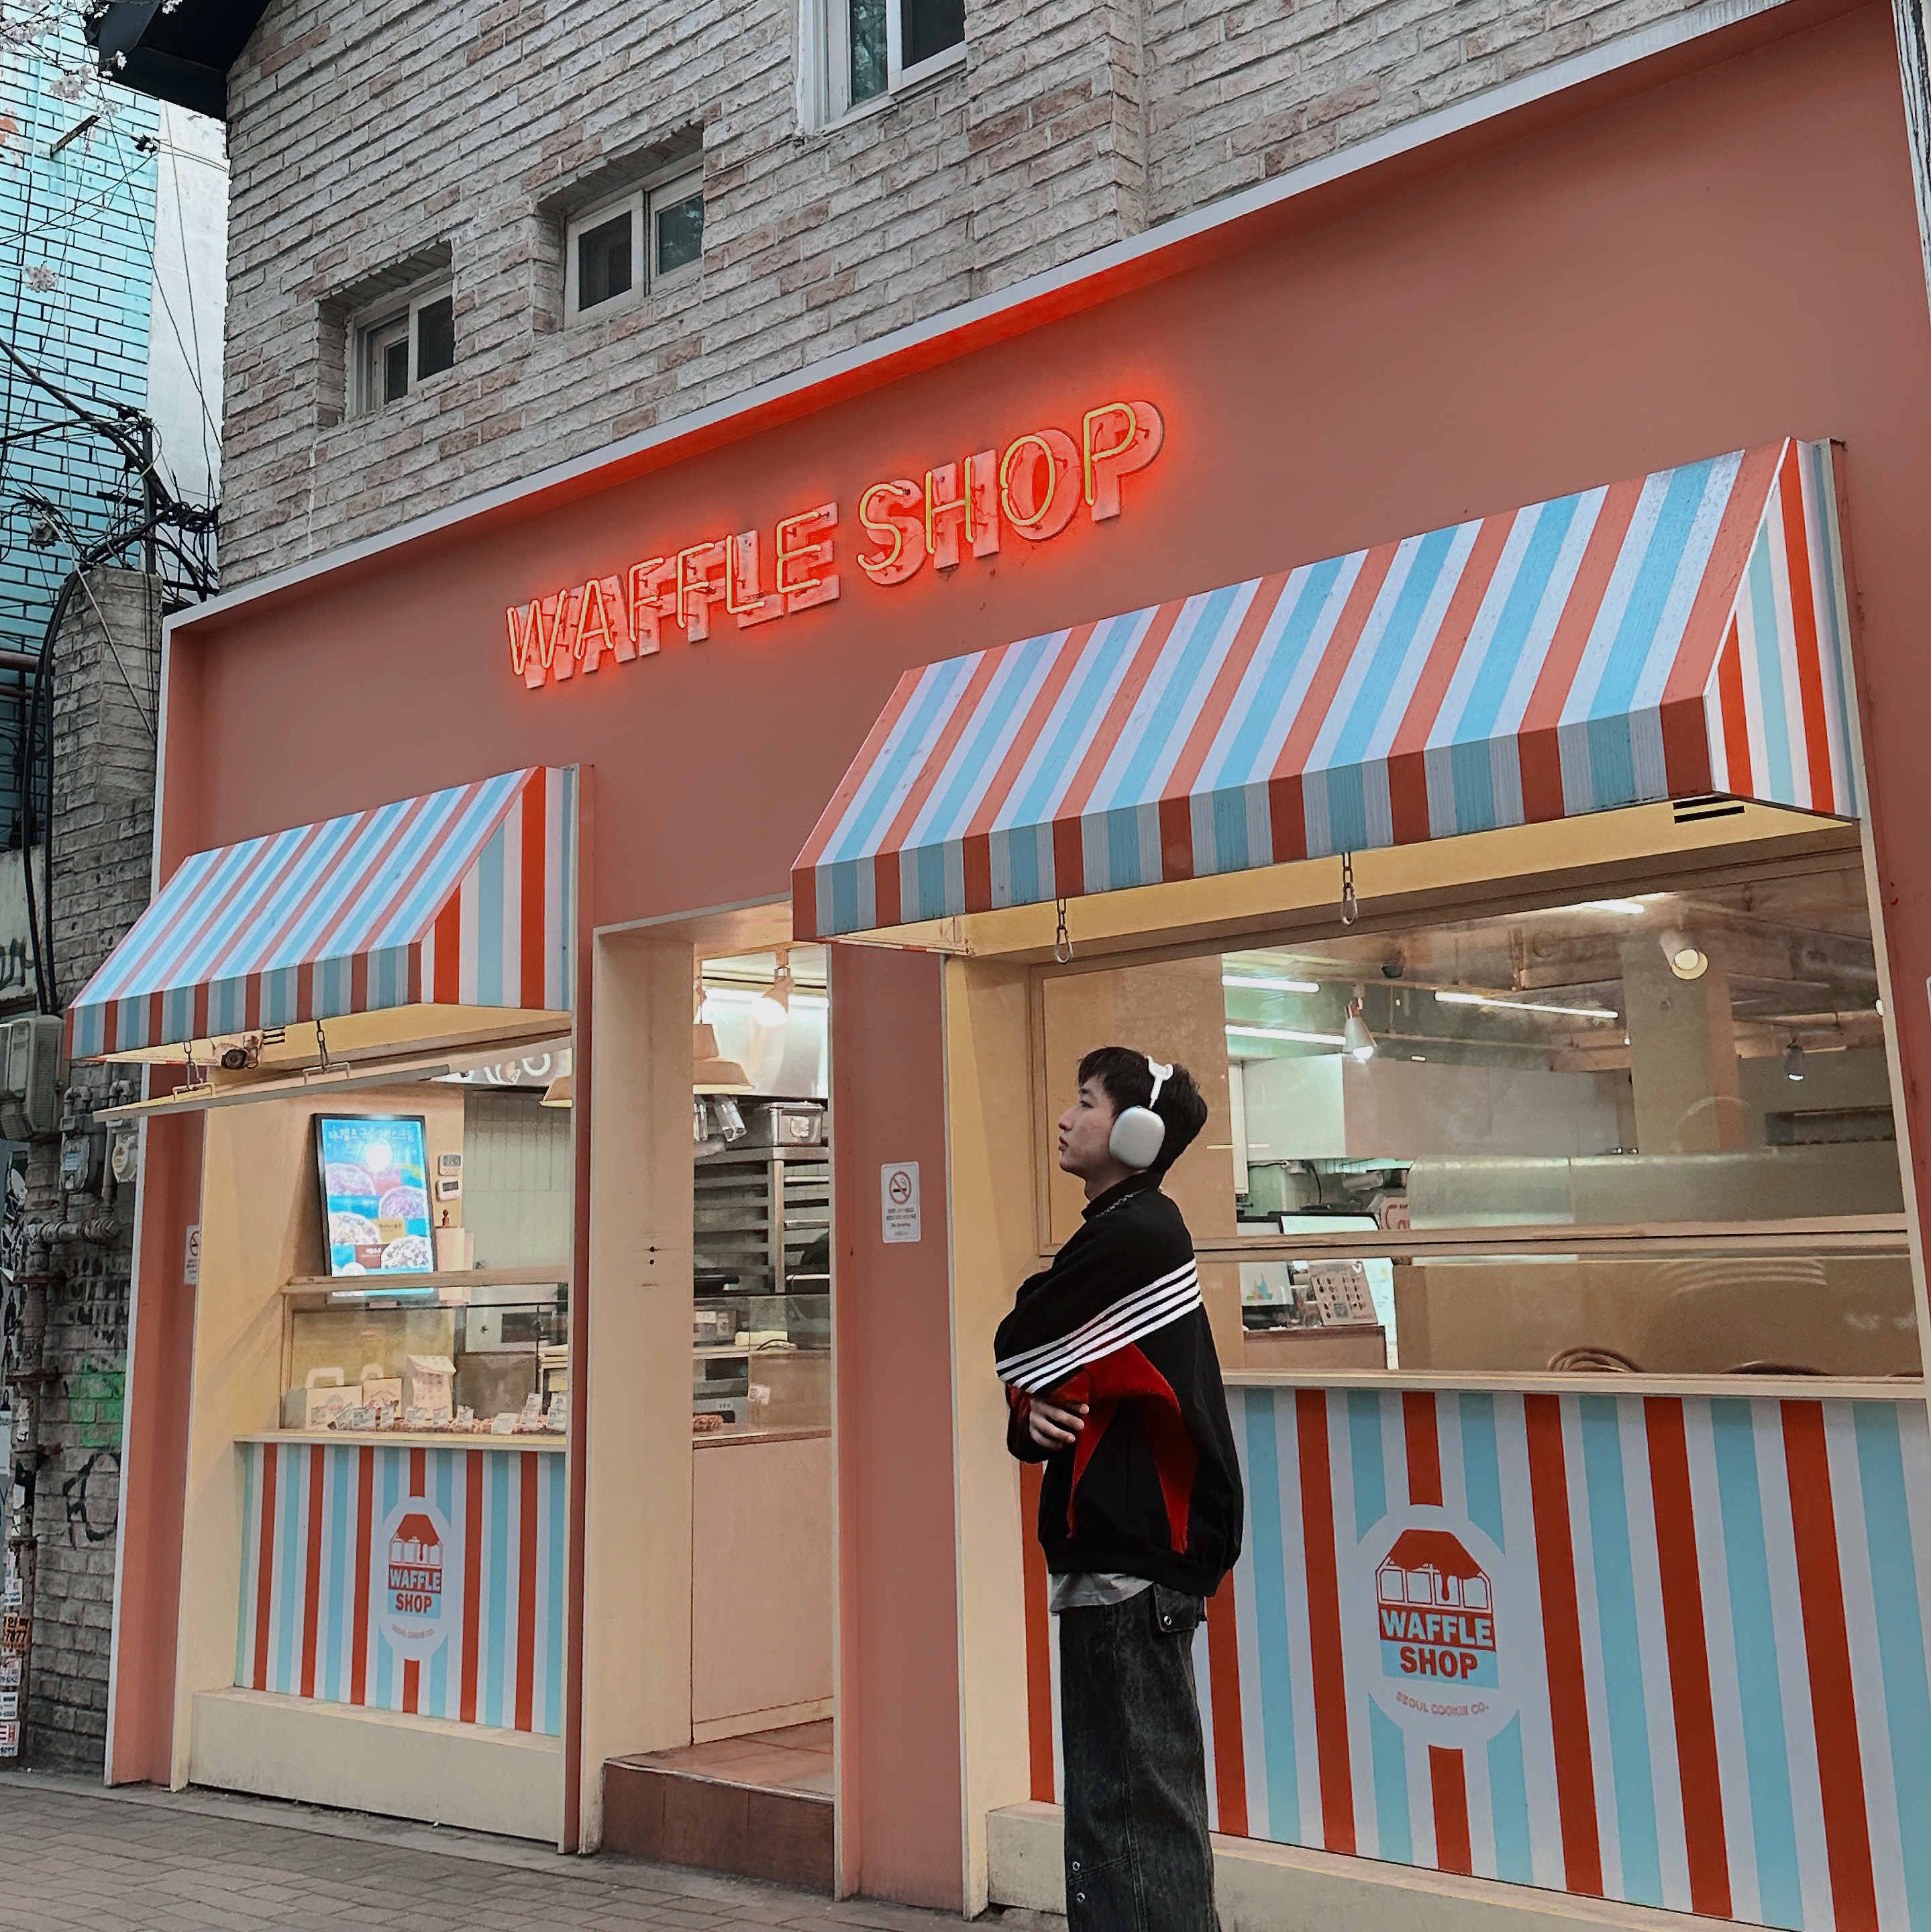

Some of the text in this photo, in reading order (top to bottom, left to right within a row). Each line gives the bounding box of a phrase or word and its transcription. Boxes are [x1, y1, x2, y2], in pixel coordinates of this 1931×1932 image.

[506, 400, 1164, 689] WAFFLE SHOP
[390, 1568, 441, 1591] WAFFLE
[396, 1592, 432, 1613] SHOP
[1380, 1609, 1494, 1647] WAFFLE
[1400, 1647, 1477, 1680] SHOP
